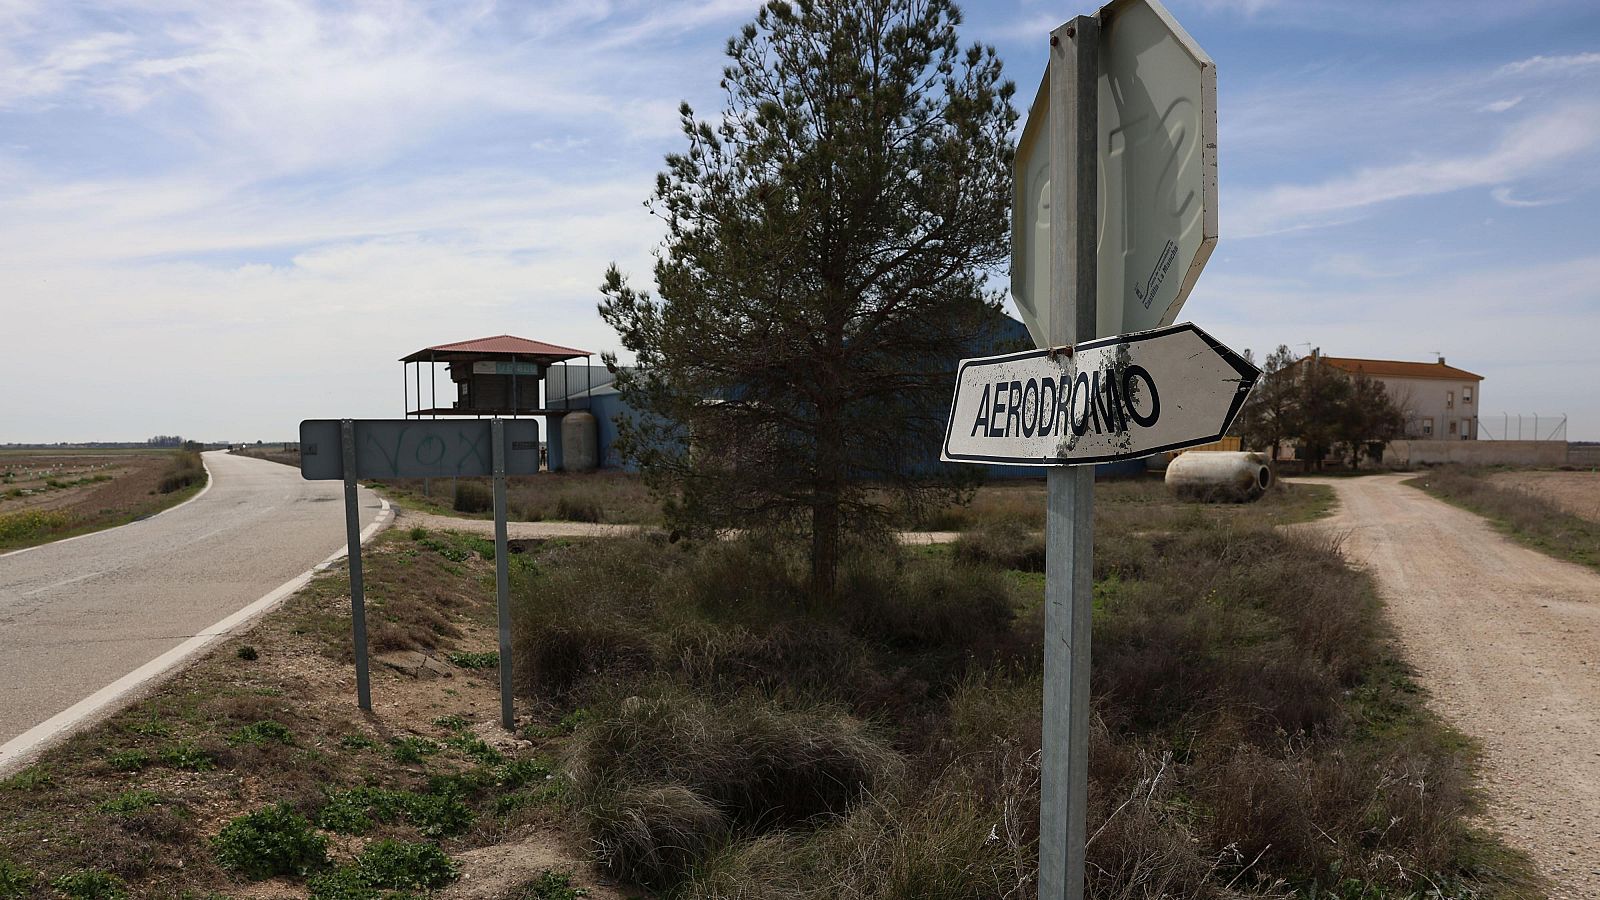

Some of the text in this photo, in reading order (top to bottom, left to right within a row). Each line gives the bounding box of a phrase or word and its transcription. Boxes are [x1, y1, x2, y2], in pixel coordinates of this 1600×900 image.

[1162, 245, 1179, 274] Mancha
[970, 364, 1161, 439] AERODROMO
[366, 427, 486, 476] VOX
